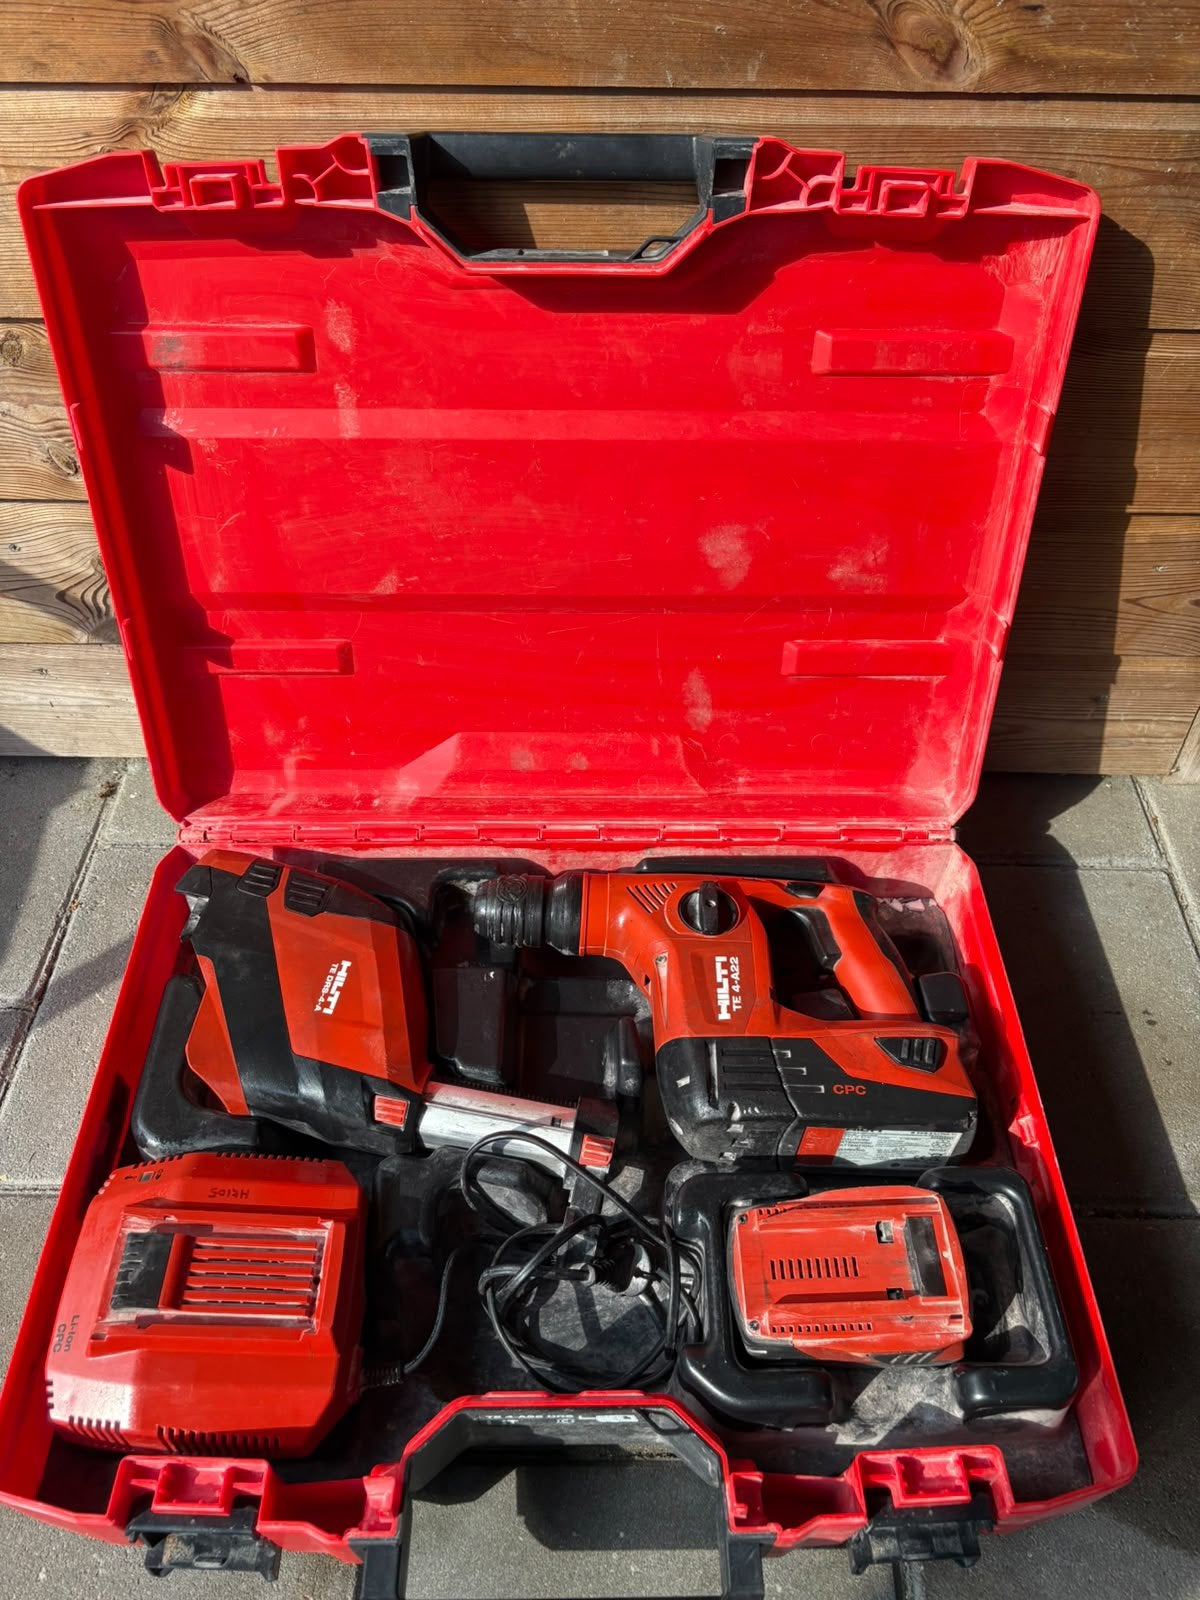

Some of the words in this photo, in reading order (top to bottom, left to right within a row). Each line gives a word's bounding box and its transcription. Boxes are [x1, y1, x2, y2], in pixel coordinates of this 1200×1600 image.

[329, 963, 339, 974] TE
[730, 956, 741, 992] 4-A22
[314, 974, 334, 1011] DRS-4-A
[322, 959, 352, 1015] HILTI
[715, 956, 731, 1020] HILTI
[732, 995, 742, 1012] TE
[832, 1084, 867, 1096] CPC
[52, 1323, 67, 1353] CPC
